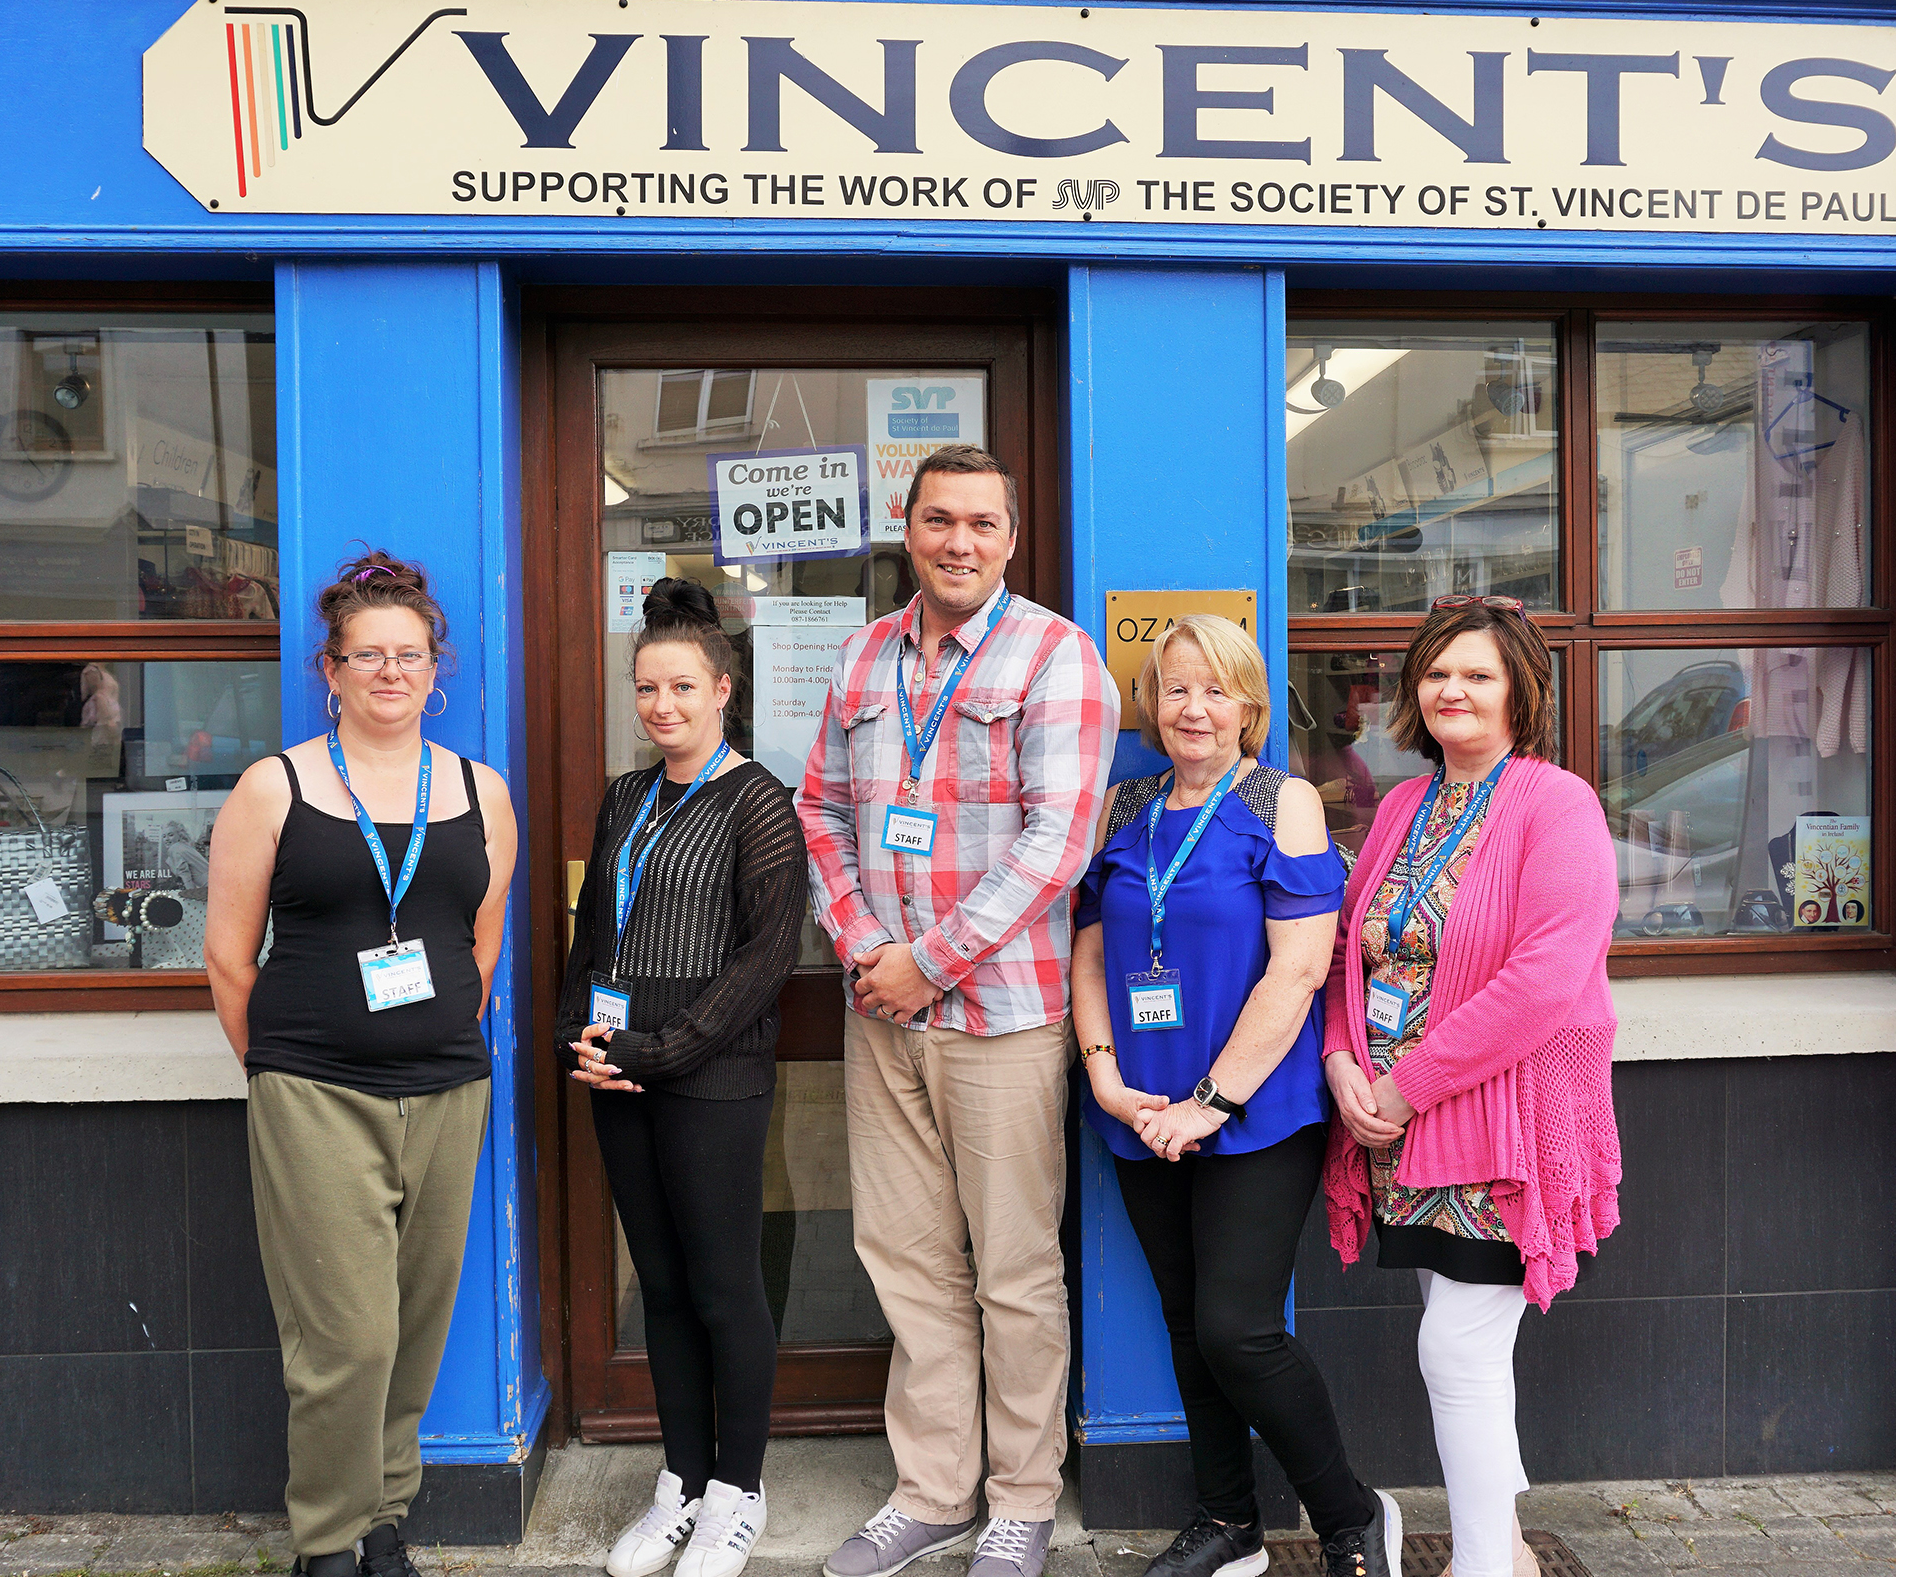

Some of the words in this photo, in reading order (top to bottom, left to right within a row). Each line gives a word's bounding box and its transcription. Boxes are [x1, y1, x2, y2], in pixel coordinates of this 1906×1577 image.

[451, 31, 1896, 171] VINCENT'S
[452, 170, 729, 205] SUPPORTING
[743, 174, 824, 205] THE
[839, 175, 969, 208] WORK
[983, 177, 1037, 209] OF
[1052, 178, 1121, 211] SVP
[1136, 180, 1216, 211] THE
[1230, 181, 1406, 215] SOCIETY
[1418, 185, 1470, 216] OF
[1484, 186, 1538, 217] ST.
[1551, 187, 1722, 219] VINCENT
[1737, 191, 1786, 220] DE
[1801, 192, 1896, 223] PAUL
[891, 386, 956, 411] SVP
[892, 416, 918, 425] Society
[920, 416, 928, 424] of
[153, 439, 199, 475] Children
[728, 463, 808, 485] Come
[819, 456, 849, 479] in
[766, 484, 812, 497] we're
[733, 497, 846, 535] OPEN
[762, 537, 838, 550] VINCENT'S
[1675, 569, 1686, 579] DO
[1686, 567, 1701, 578] NOT
[1678, 577, 1698, 586] ENTER
[801, 600, 822, 608] looking
[833, 600, 848, 608] Help
[772, 642, 791, 652] Shop
[793, 642, 825, 651] Opening
[772, 665, 804, 674] Monday
[815, 665, 833, 673] Frida
[772, 676, 832, 685] 10.00am-4.00p
[772, 698, 806, 708] Saturday
[899, 691, 912, 737] VINCENT'S
[924, 695, 949, 743] VINCENT'S
[418, 773, 432, 814] VINCENT'S
[1193, 790, 1222, 834] VINCENT'S
[1454, 788, 1488, 836] VINCENT'S
[1840, 823, 1860, 832] Family
[894, 833, 922, 846] STAFF
[403, 832, 423, 882] VINCENT'S
[125, 870, 138, 879] WE
[140, 869, 155, 879] ARE
[157, 869, 172, 878] ALL
[125, 880, 151, 889] STARS
[1406, 862, 1442, 910] VINCENT'S
[382, 981, 421, 1001] STAFF
[597, 1011, 622, 1027] STAFF
[1139, 1009, 1171, 1022] STAFF
[1372, 1008, 1393, 1024] STAFF
